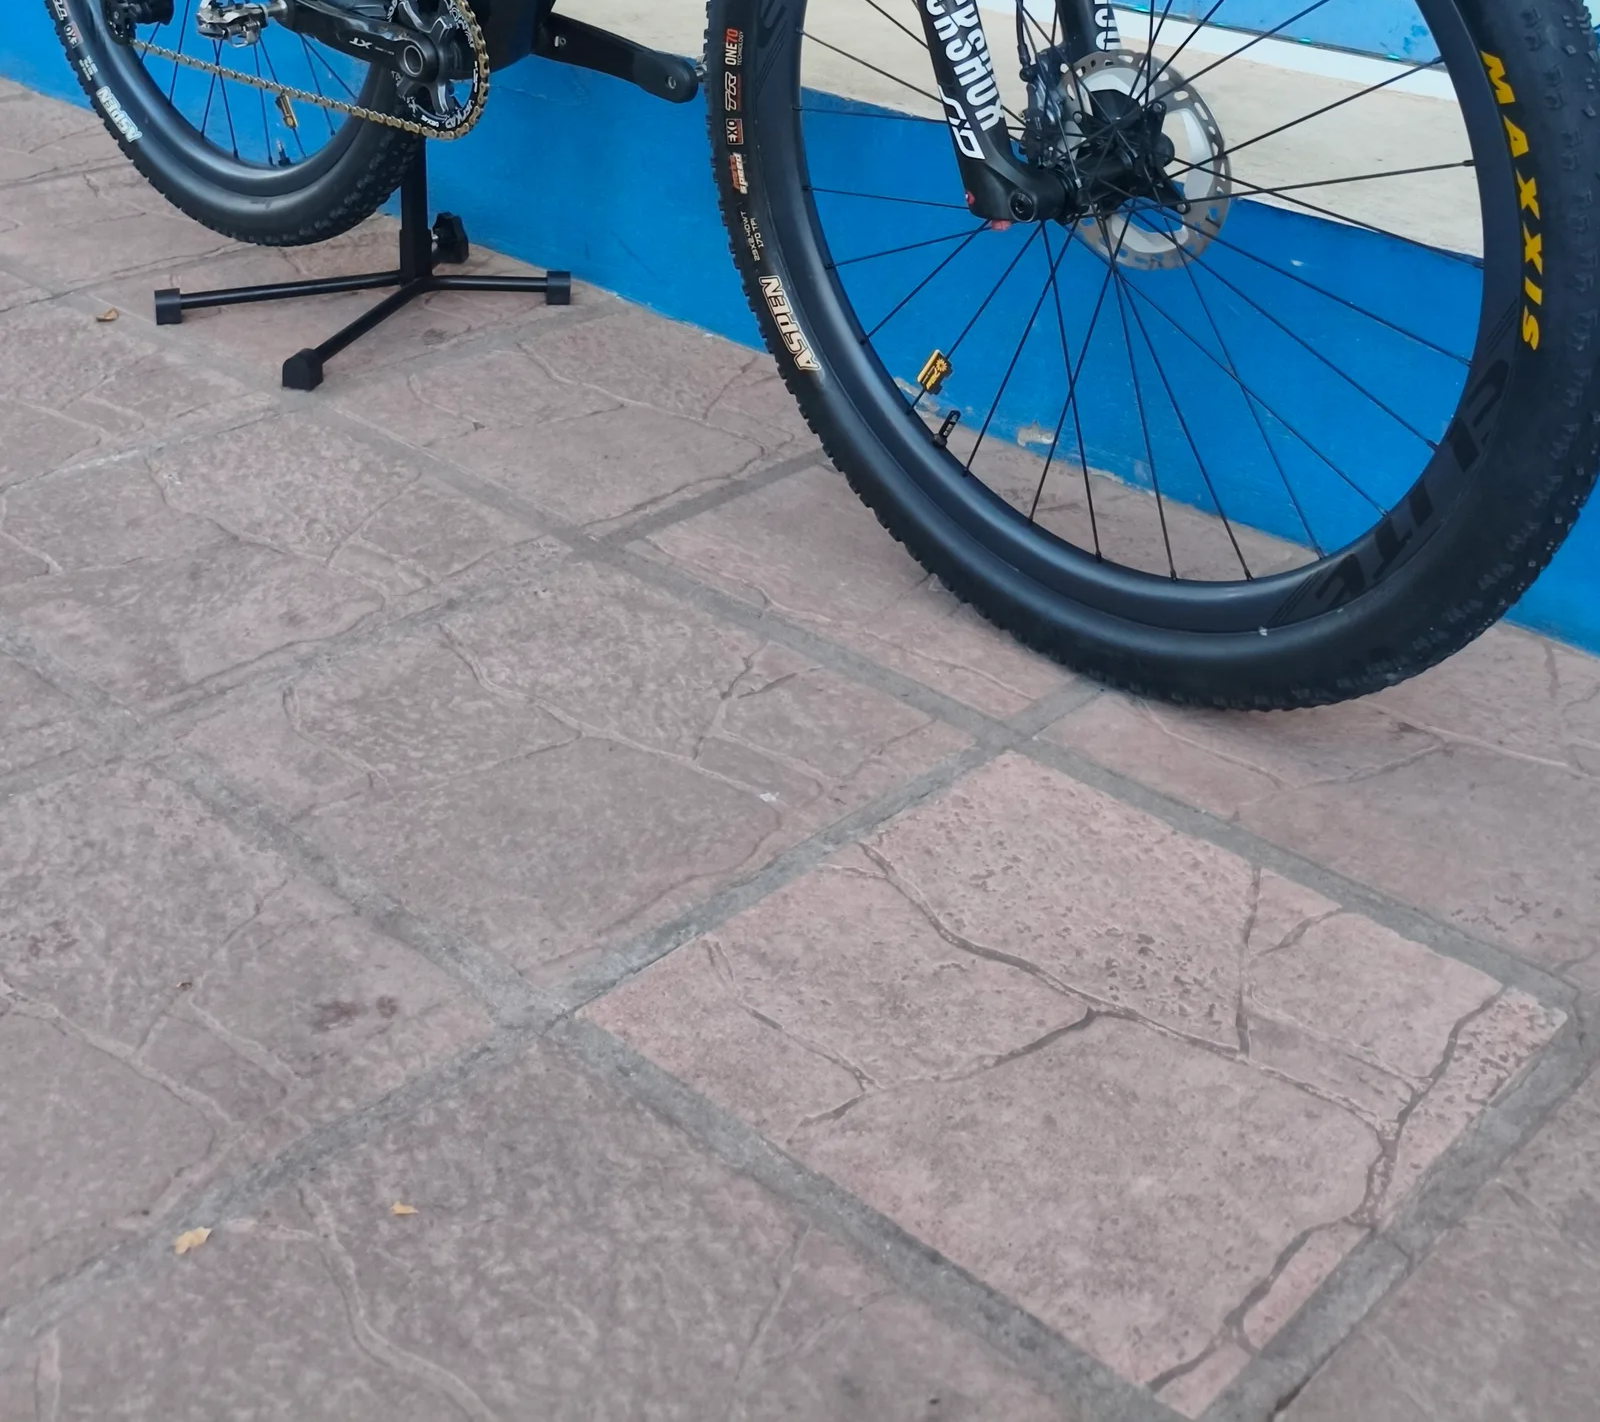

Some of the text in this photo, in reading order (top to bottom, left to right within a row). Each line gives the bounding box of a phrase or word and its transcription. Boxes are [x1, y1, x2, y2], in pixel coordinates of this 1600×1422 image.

[725, 28, 739, 66] ONE70
[726, 118, 738, 144] EXO
[1480, 49, 1543, 351] MAXXIS
[759, 275, 821, 370] ASPEN
